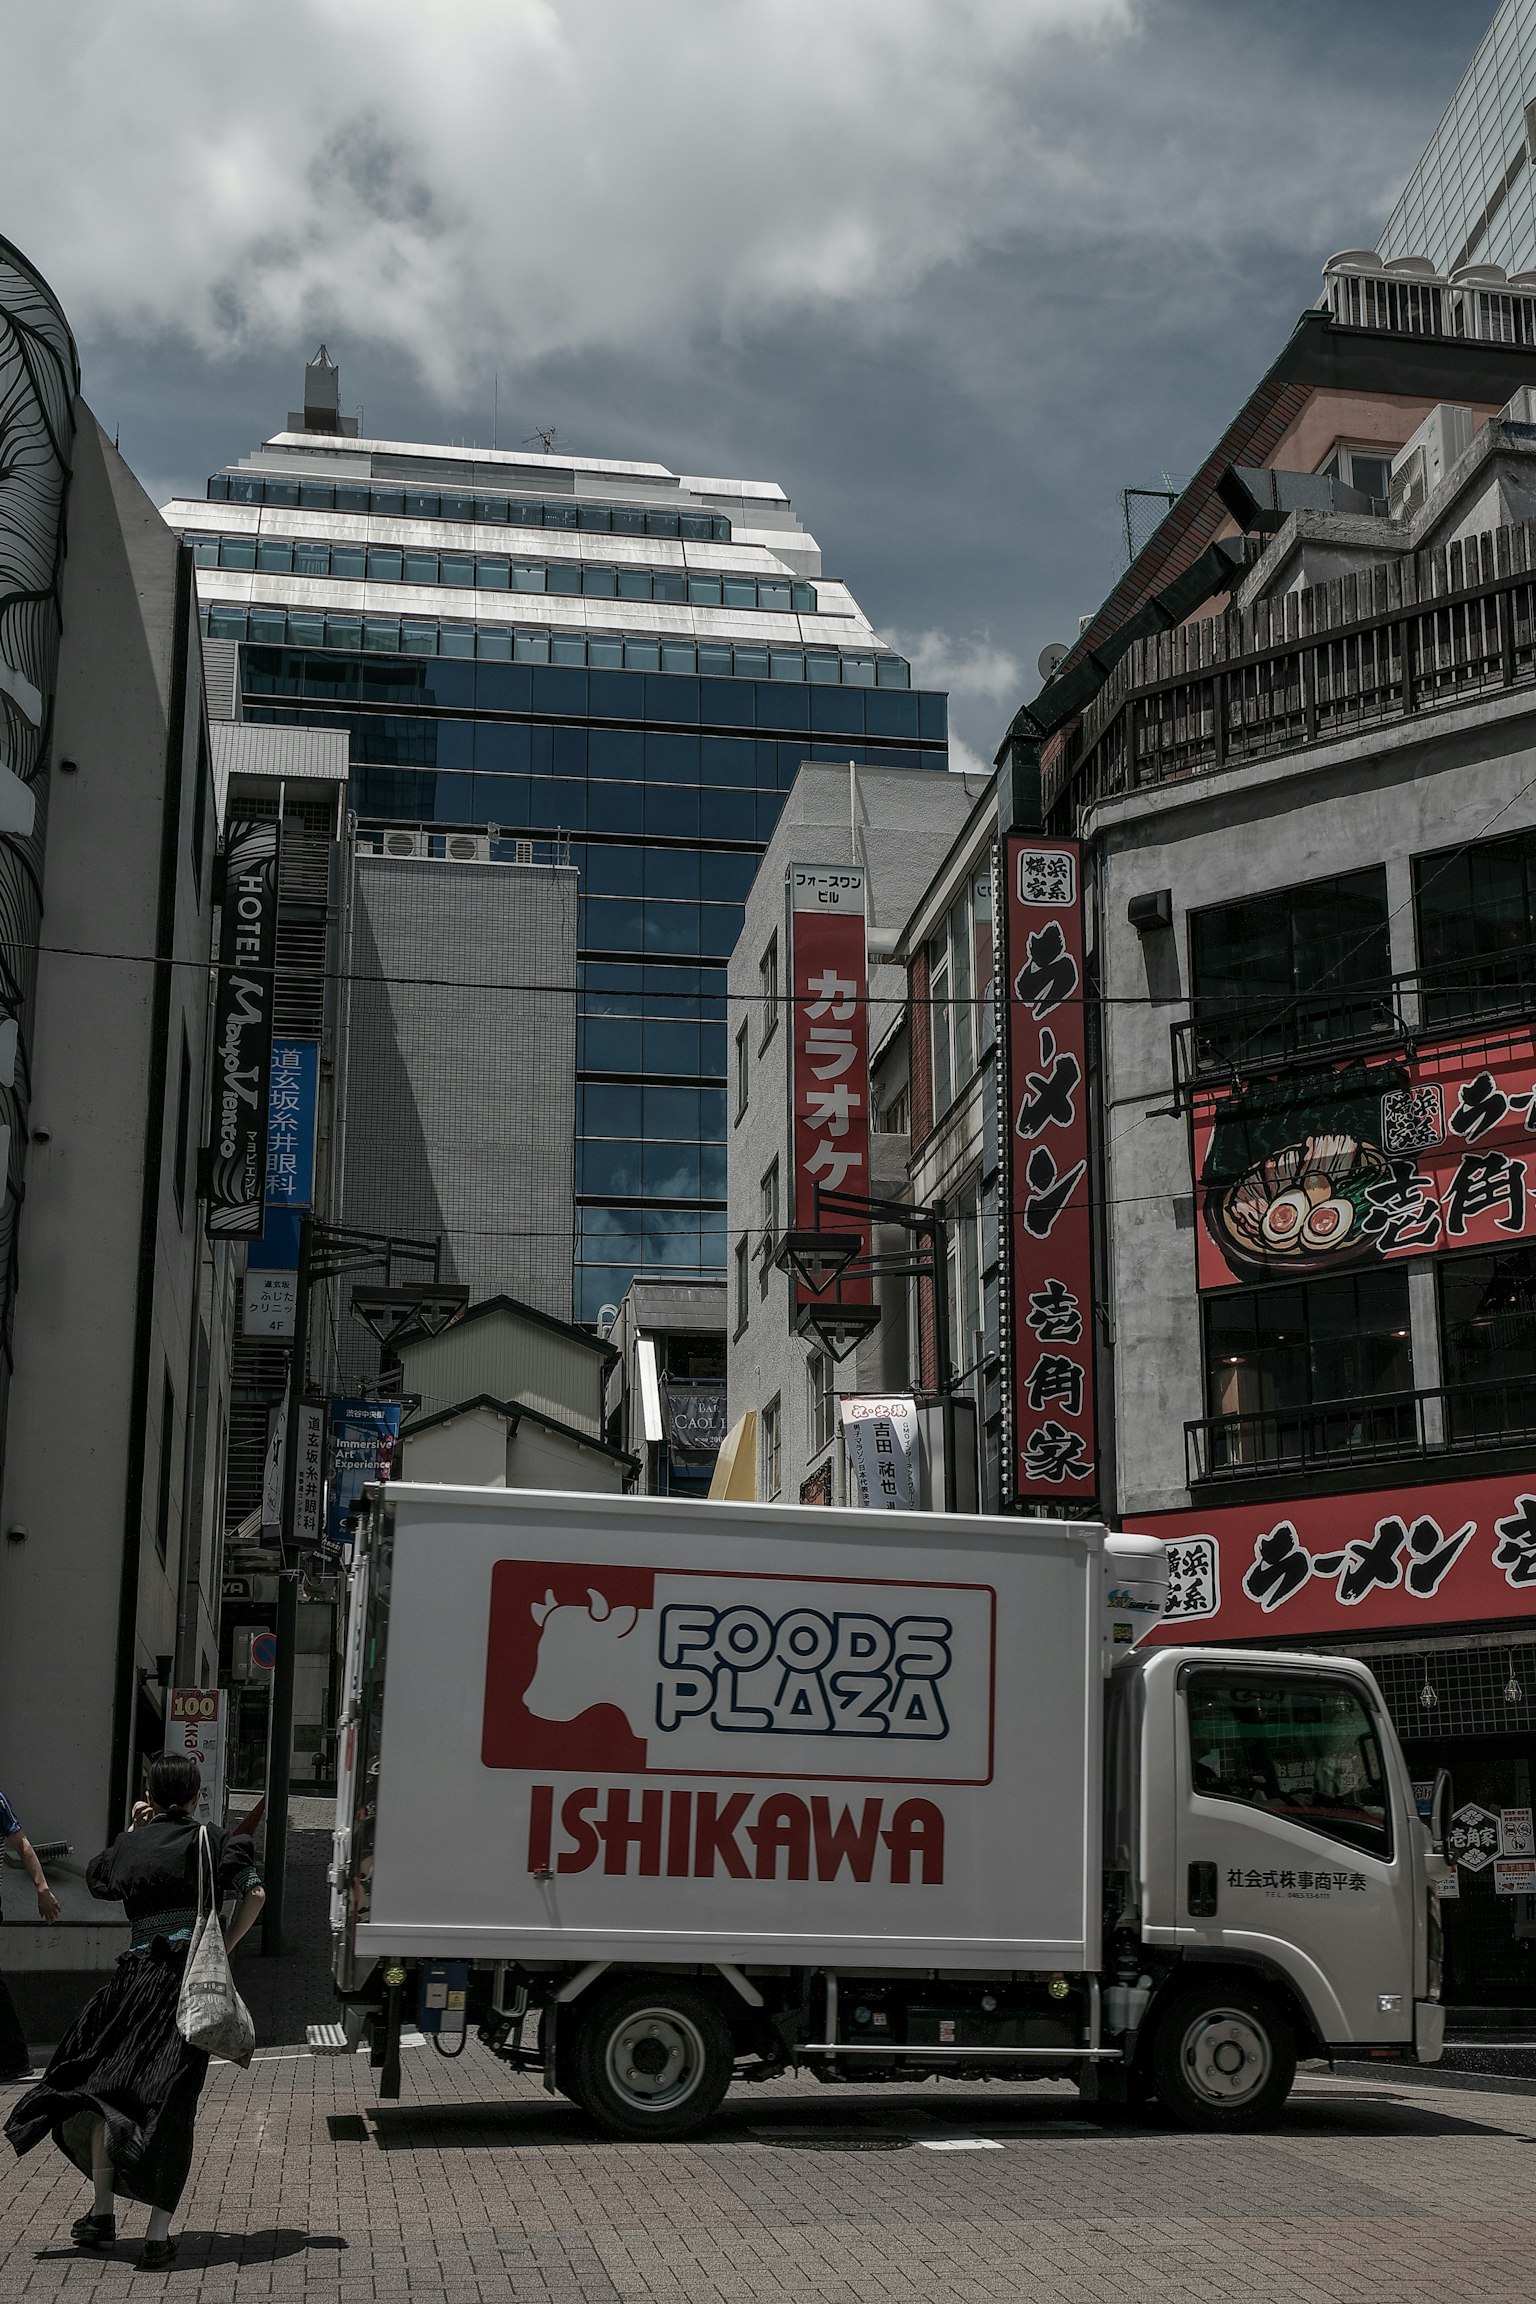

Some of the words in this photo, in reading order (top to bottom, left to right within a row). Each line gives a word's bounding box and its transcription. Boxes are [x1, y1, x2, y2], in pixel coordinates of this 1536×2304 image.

[795, 872, 861, 889] フォースワン
[1025, 856, 1068, 878] 横浜
[235, 875, 264, 966] HOTEL
[818, 890, 840, 904] ビル
[802, 969, 864, 1194] カラオケ
[1014, 919, 1087, 1242] ラーメン
[265, 1047, 303, 1197] 道玄坂糸井眼科
[1449, 1071, 1536, 1144] ラー
[245, 1131, 258, 1201] マヨビエント
[1361, 1151, 1536, 1253] 壱角
[261, 1291, 294, 1302] ふじた
[264, 1280, 290, 1289] 道玄坂
[269, 1321, 284, 1330] 4F
[1021, 1276, 1095, 1483] 壱角家
[336, 1438, 393, 1449] Immersive
[674, 1414, 717, 1429] CAOL
[873, 1422, 893, 1454] 吉田
[303, 1416, 321, 1531] 道玄坂糸井眼科
[335, 1459, 392, 1470] Experience
[336, 1450, 355, 1459] Art
[878, 1461, 898, 1496] 祐也
[1242, 1514, 1477, 1613] ラーメン
[658, 1602, 953, 1680] FOODS
[655, 1665, 950, 1741] PLAZA
[527, 1785, 944, 1885] ISHIKAWA
[1450, 1826, 1497, 1848] 壱角家
